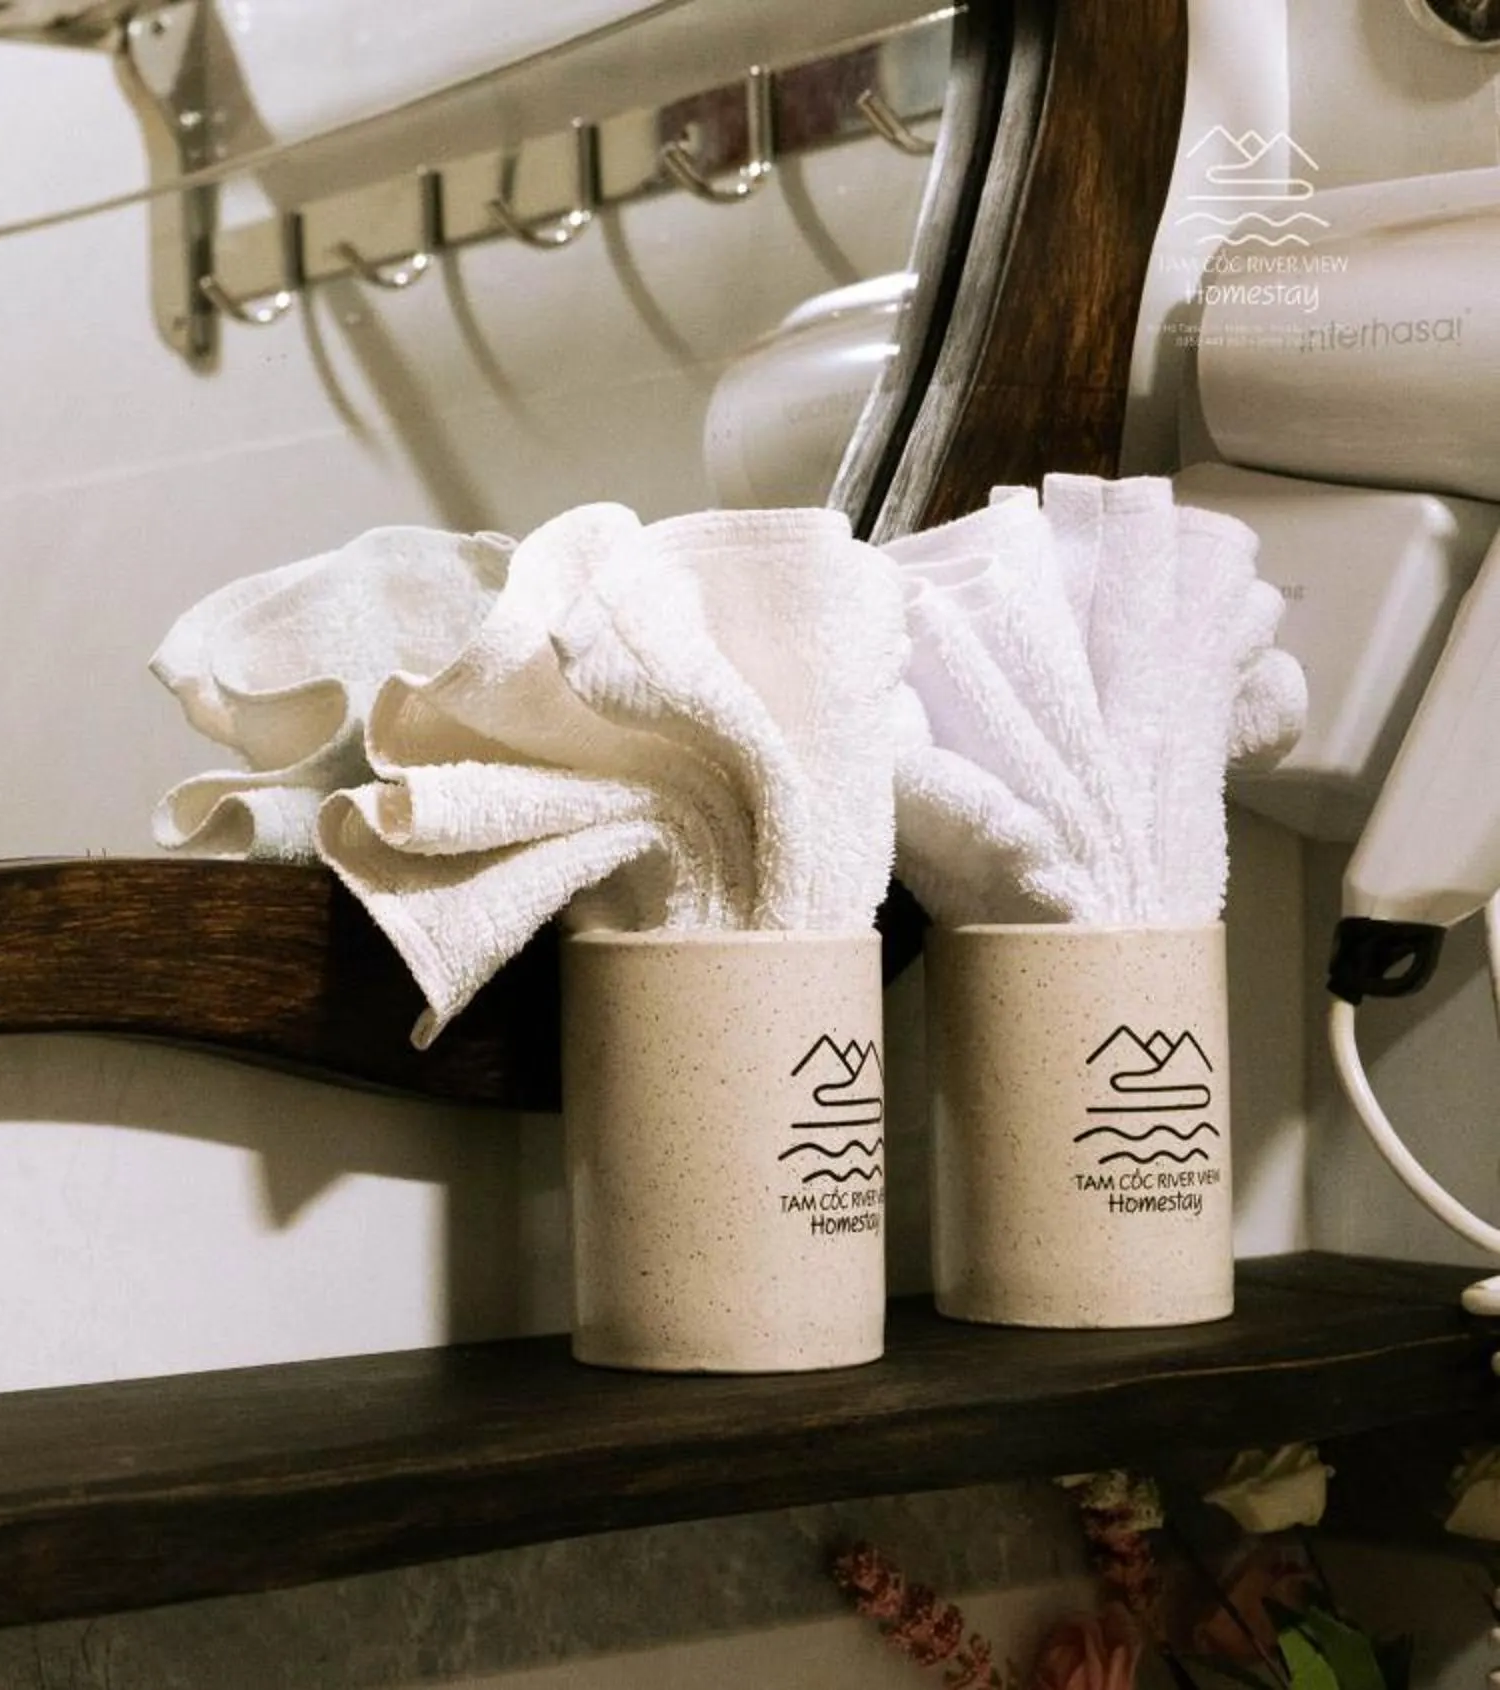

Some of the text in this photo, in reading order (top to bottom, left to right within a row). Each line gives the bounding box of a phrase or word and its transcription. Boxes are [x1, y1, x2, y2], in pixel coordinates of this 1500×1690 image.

[1076, 1174, 1115, 1191] TAM
[1157, 1171, 1194, 1189] RIVER
[780, 1193, 817, 1212] TAM
[1108, 1191, 1203, 1216] Homestay
